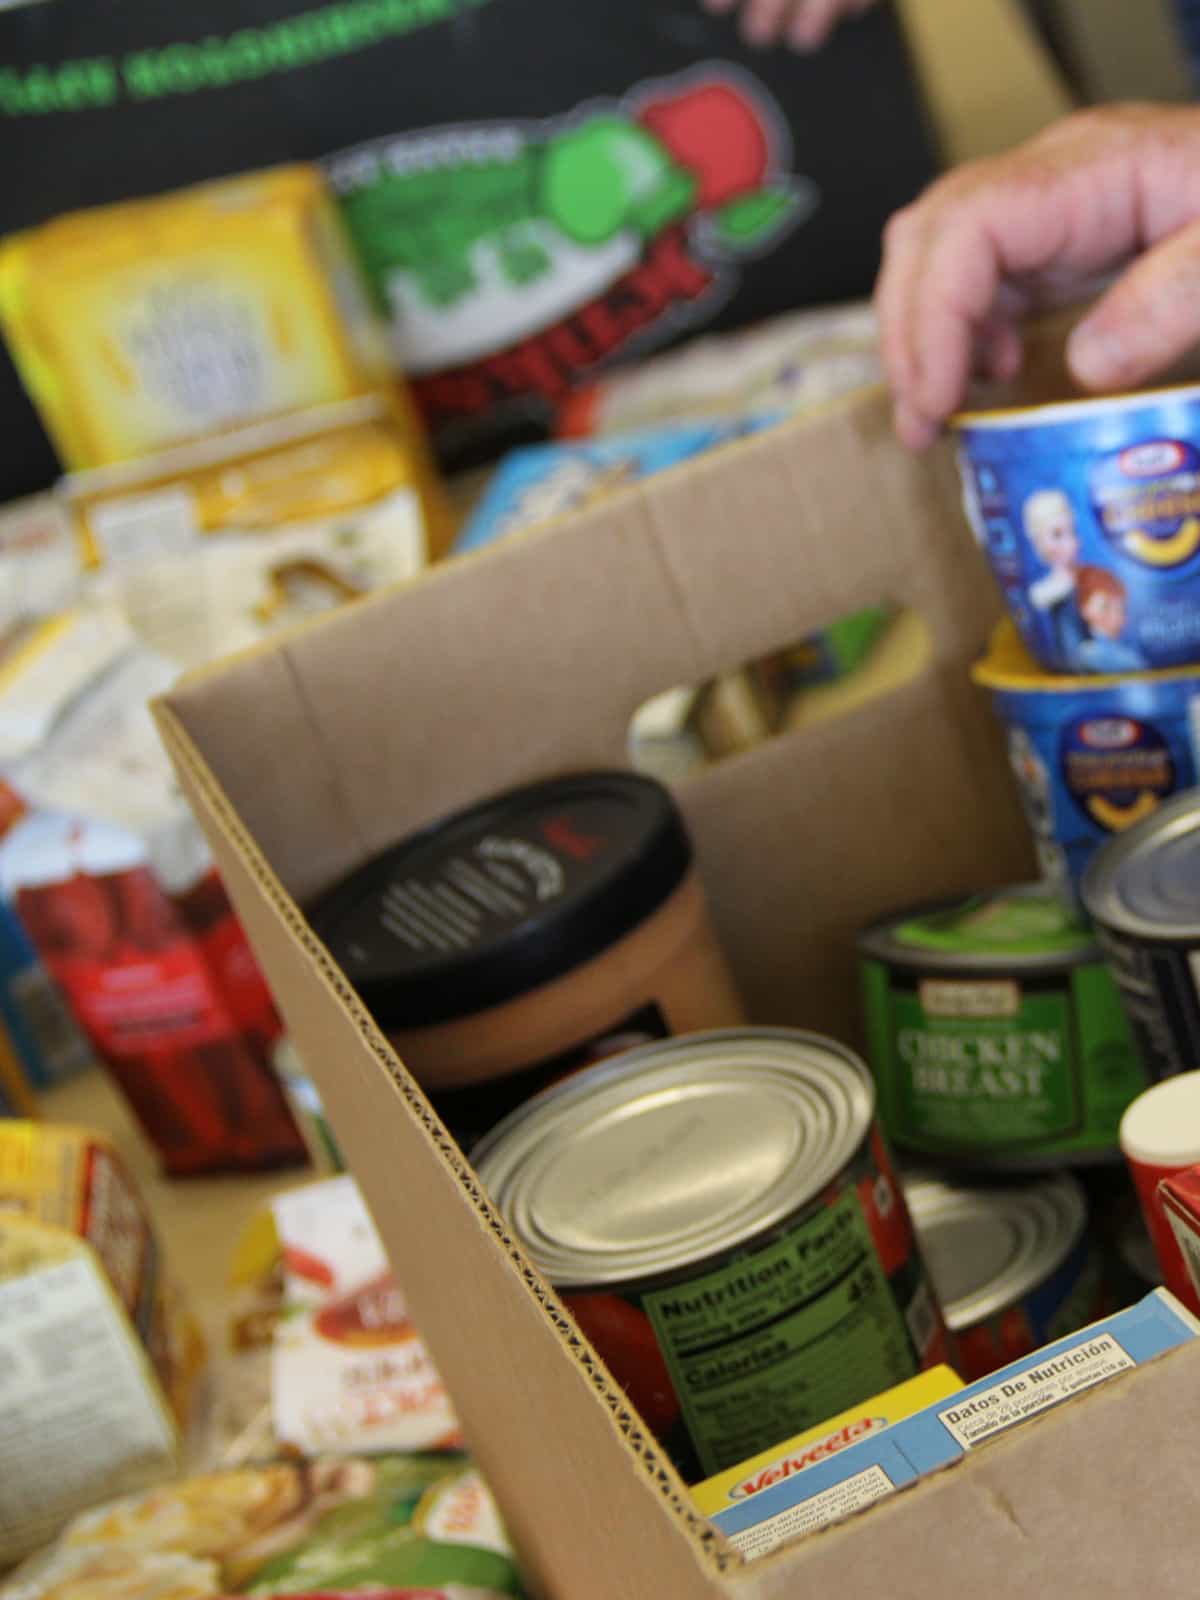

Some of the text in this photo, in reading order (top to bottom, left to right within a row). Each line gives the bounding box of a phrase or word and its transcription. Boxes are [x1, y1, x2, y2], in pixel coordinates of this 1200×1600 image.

[897, 1028, 1061, 1063] CHICKEN
[912, 1064, 1044, 1097] BREAST
[660, 1257, 791, 1320] Nutrition
[685, 1340, 790, 1385] Calories
[946, 1340, 1113, 1425] Datos De Nutrición
[741, 1417, 873, 1495] Velveeta
